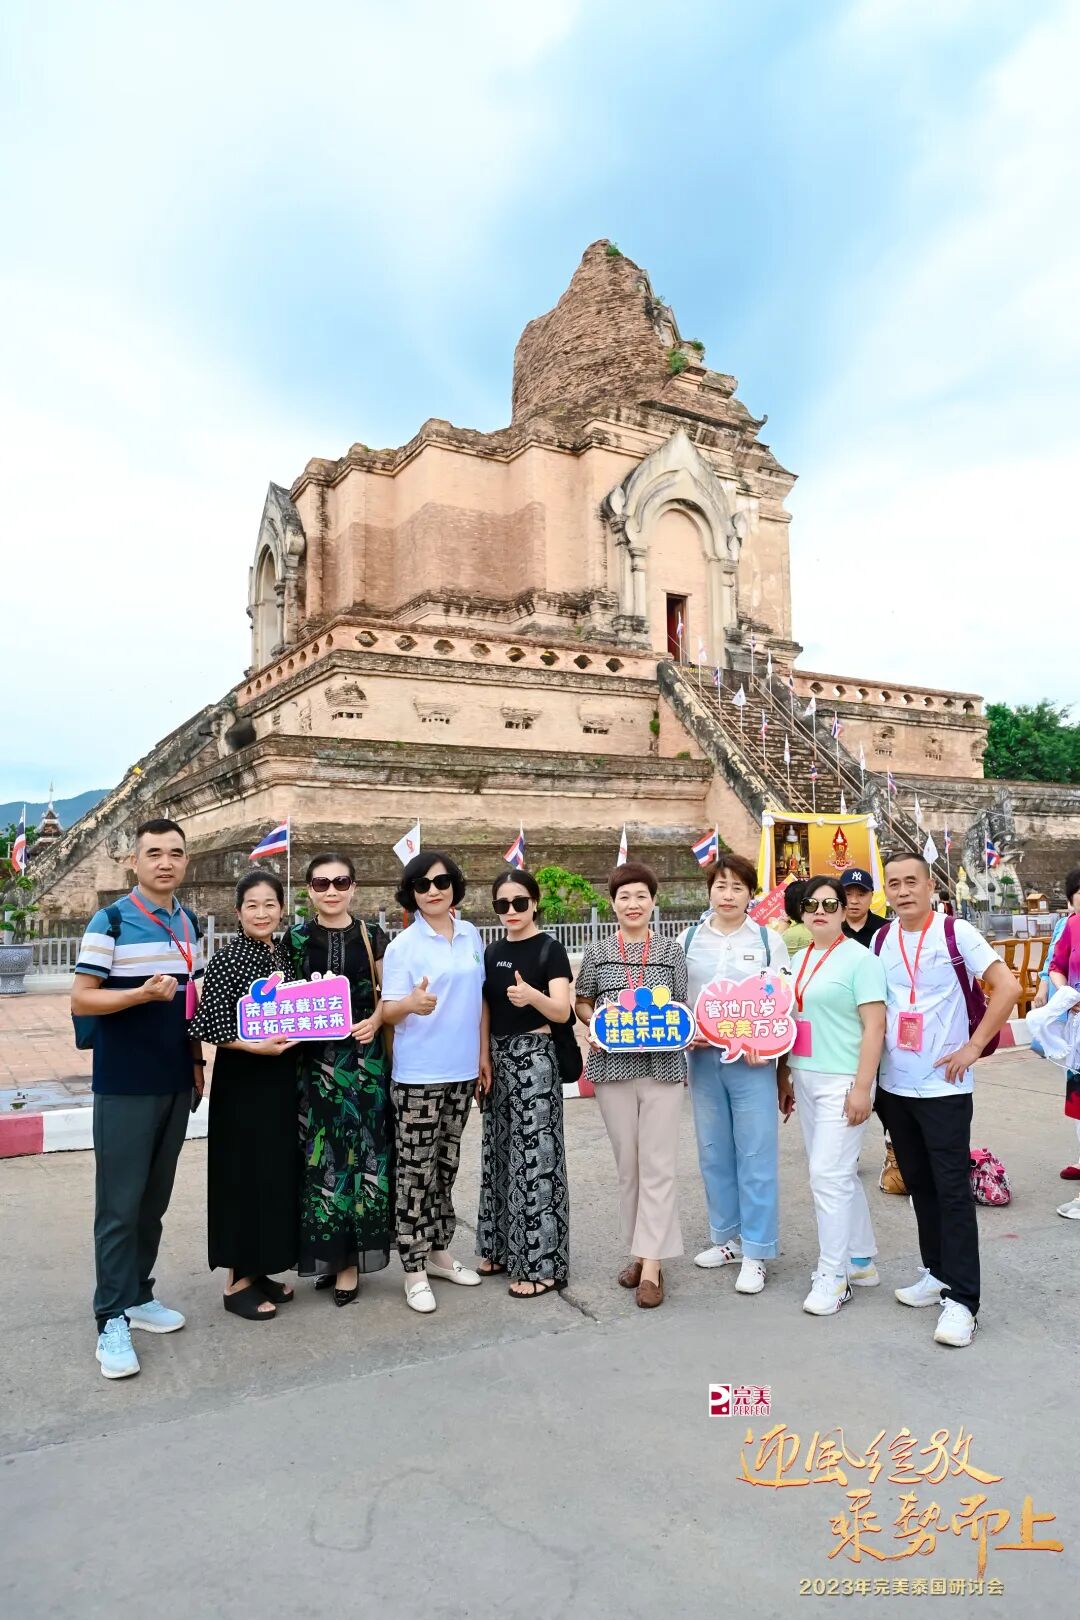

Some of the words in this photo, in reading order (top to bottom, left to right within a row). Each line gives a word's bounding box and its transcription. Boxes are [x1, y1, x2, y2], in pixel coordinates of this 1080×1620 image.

[245, 996, 343, 1018] 荣誉承载过去
[704, 999, 776, 1019] 管他几岁
[246, 1013, 345, 1036] 开拓完美未来
[604, 1009, 681, 1028] 完美在一起
[605, 1026, 682, 1043] 注定不平凡
[717, 1019, 789, 1038] 完美万岁
